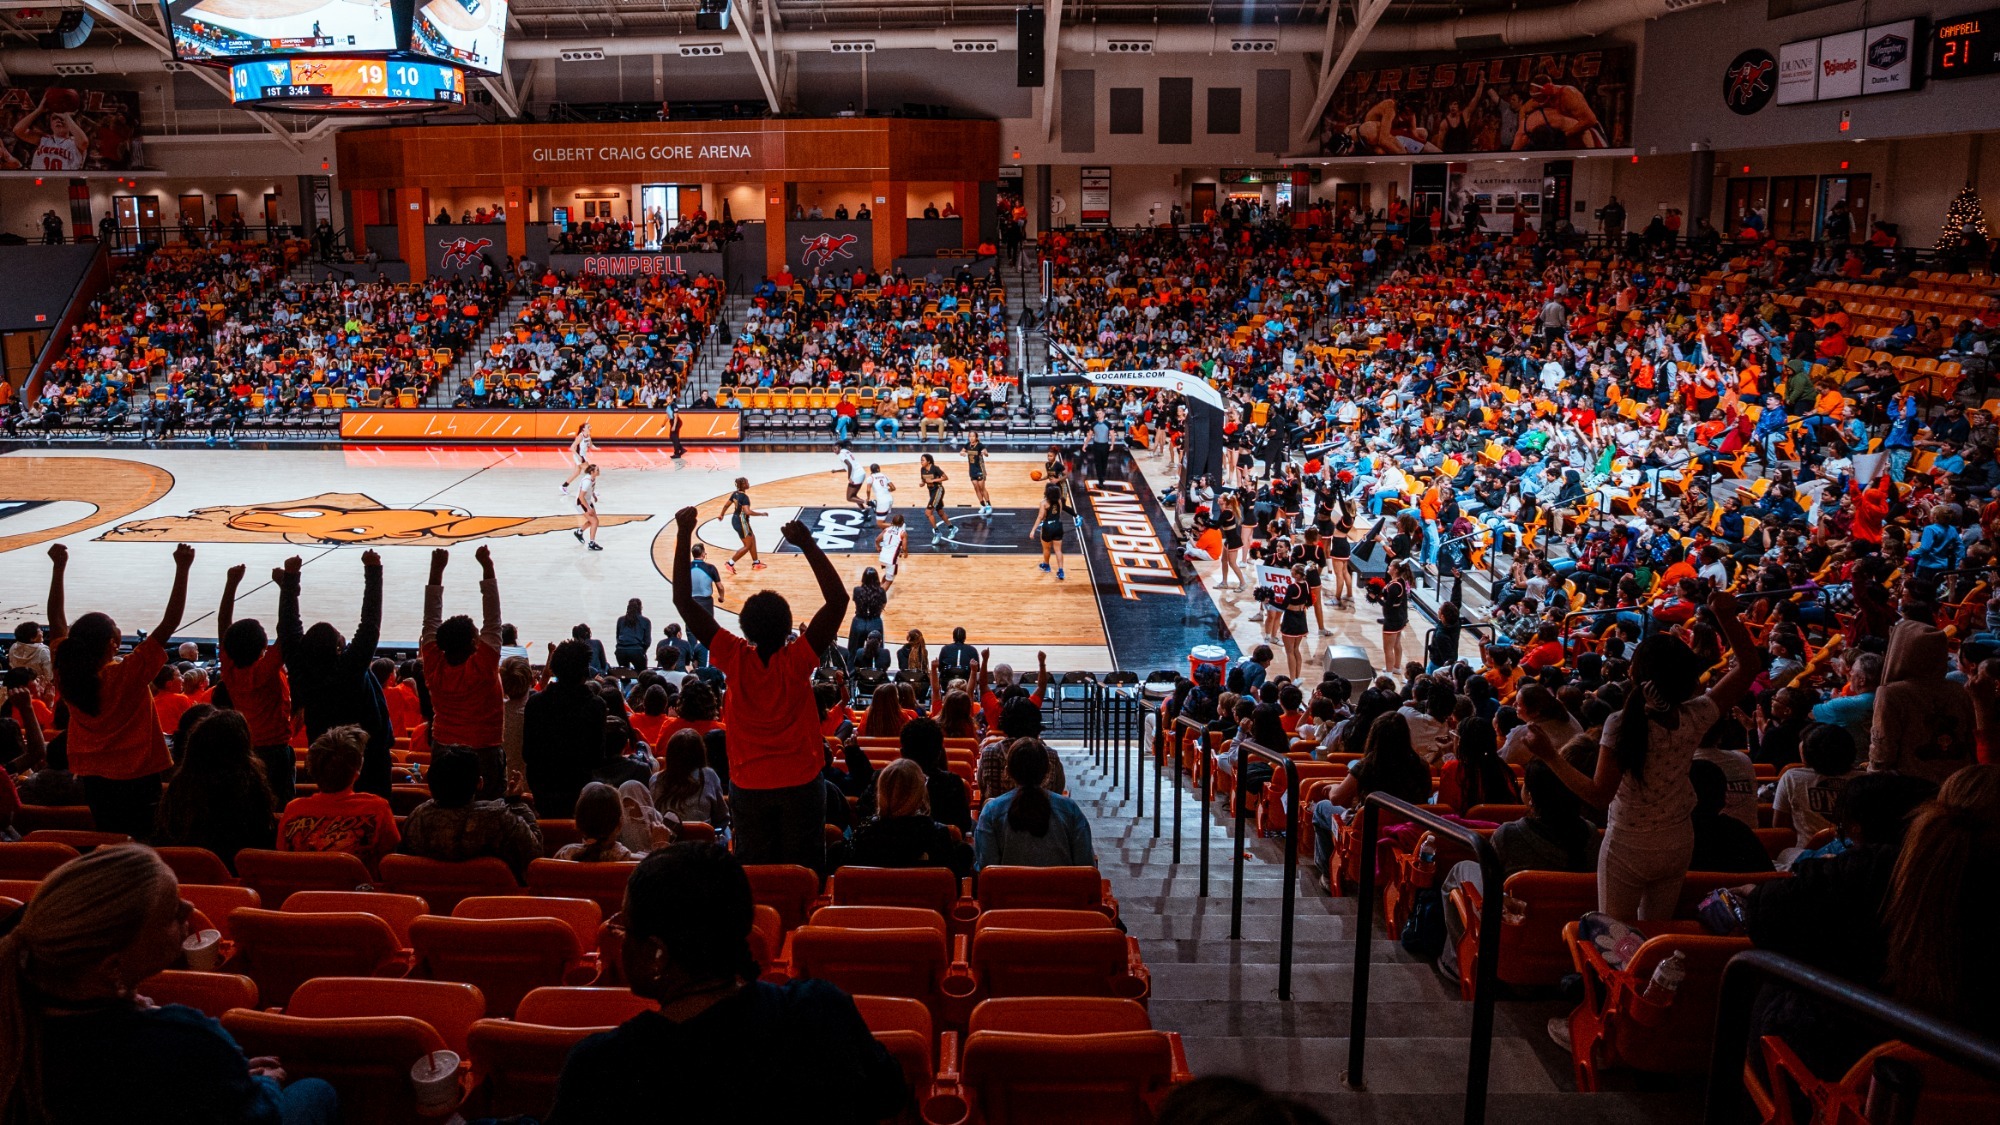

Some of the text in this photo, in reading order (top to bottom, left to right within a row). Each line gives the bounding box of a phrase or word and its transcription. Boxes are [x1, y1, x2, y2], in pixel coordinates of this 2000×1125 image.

[1939, 21, 1982, 39] CAMPBELL
[1942, 40, 1970, 68] 21
[235, 69, 248, 88] 10
[357, 65, 383, 84] 19
[396, 66, 419, 86] 10
[1346, 52, 1603, 93] WRESTLING
[1890, 73, 1900, 81] NC
[266, 87, 282, 96] 1ST
[288, 86, 310, 96] 3:44
[404, 88, 412, 97] 4
[439, 90, 451, 99] 1ST
[532, 145, 752, 162] GILBERT CRAIG GORE ARENA
[584, 255, 687, 276] CAMPBELL
[1095, 371, 1166, 380] GOCAMELS.COM
[1176, 381, 1184, 392] C
[811, 508, 865, 550] CAA
[1084, 479, 1187, 601] CAMPBELL
[1265, 572, 1292, 585] LET'S
